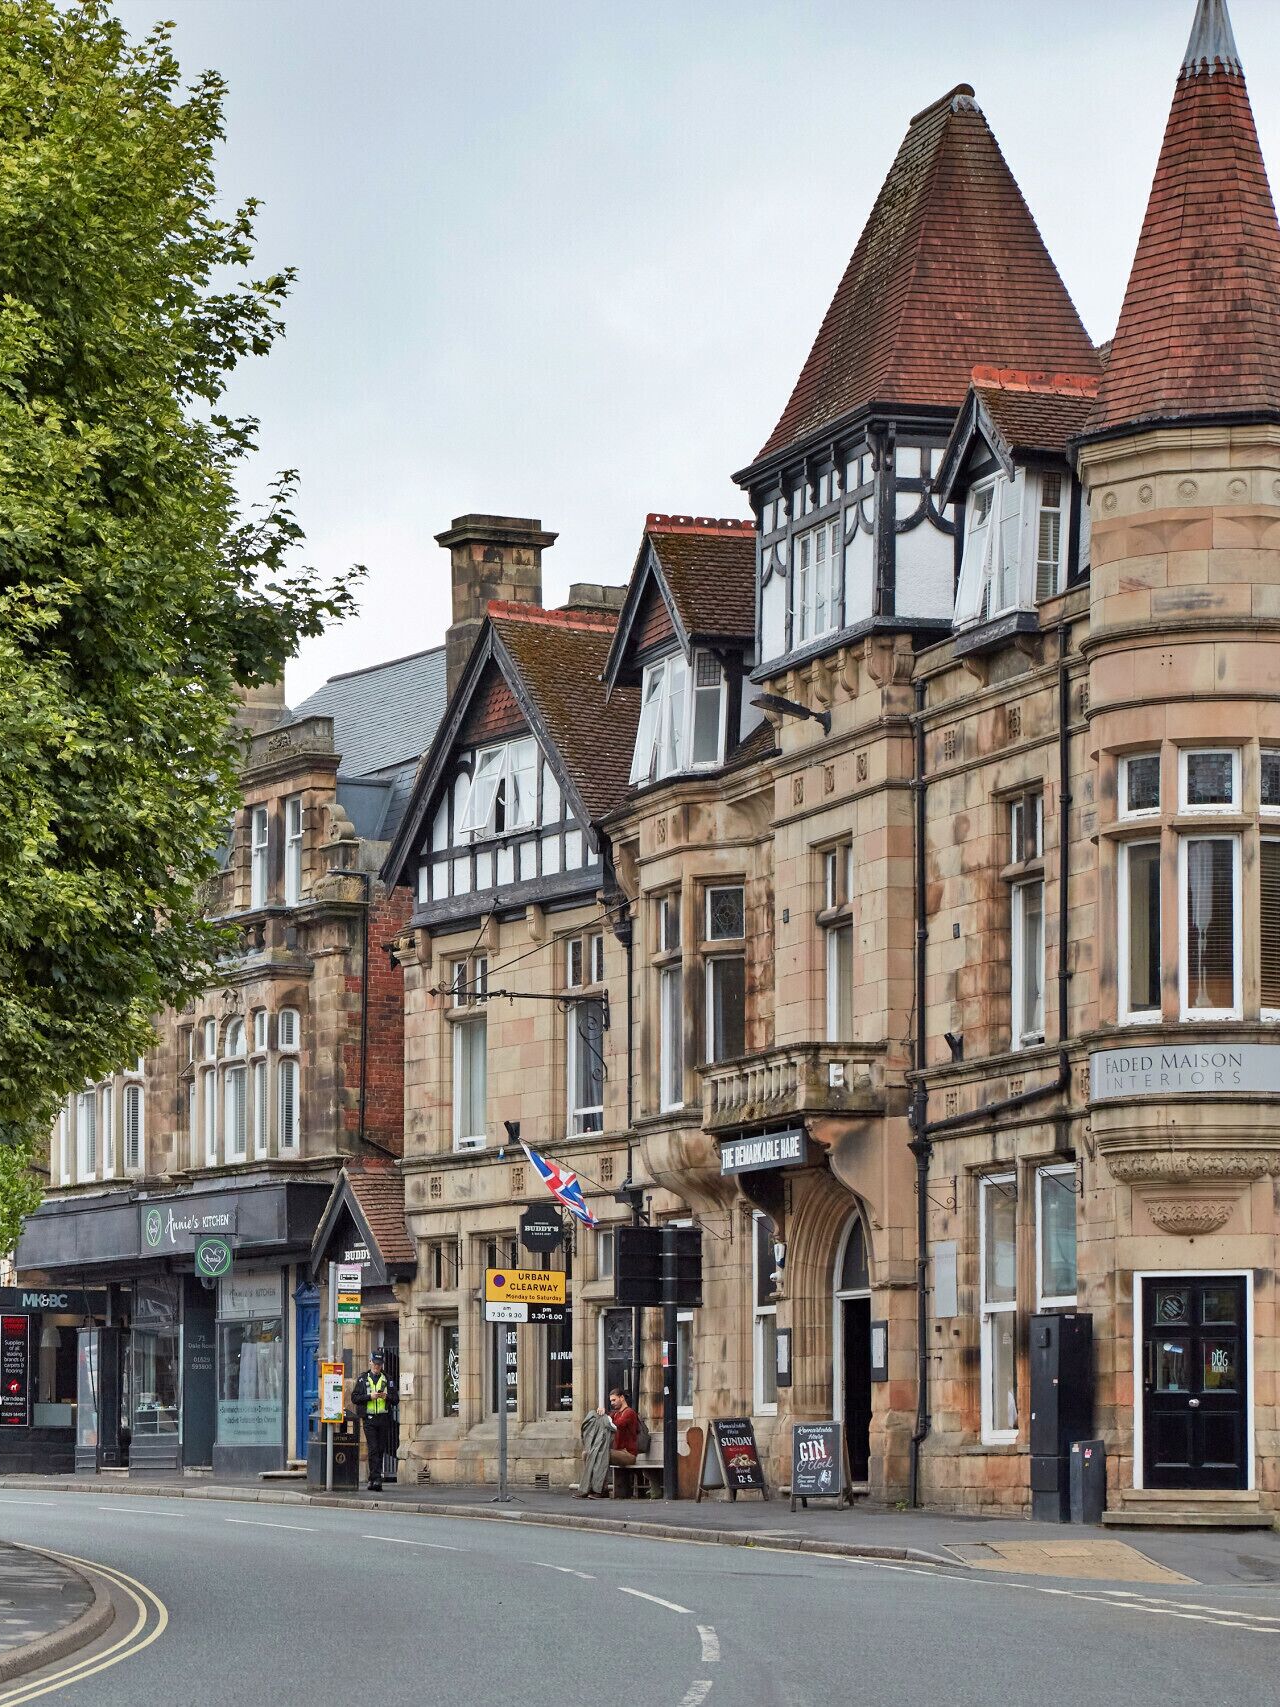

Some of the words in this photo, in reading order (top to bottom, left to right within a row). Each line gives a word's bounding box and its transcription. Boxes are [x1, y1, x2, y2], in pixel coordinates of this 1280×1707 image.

[1106, 1056, 1153, 1074] FADED
[1160, 1053, 1242, 1069] MAISON
[1106, 1071, 1241, 1090] INTERIORS
[721, 1147, 735, 1170] THE
[735, 1139, 780, 1167] REMARKABLE
[780, 1135, 800, 1159] HARE
[164, 1208, 199, 1244] Annie's
[202, 1213, 229, 1228] KITCHEN
[344, 1249, 371, 1261] BUDDY
[518, 1273, 550, 1281] URBAN
[509, 1283, 559, 1292] CLEARWAY
[22, 1293, 68, 1308] MK&BC
[1211, 1349, 1228, 1366] DOG
[797, 1426, 833, 1435] Remarkable
[720, 1436, 753, 1446] SUNDAY
[799, 1439, 827, 1462] GIN
